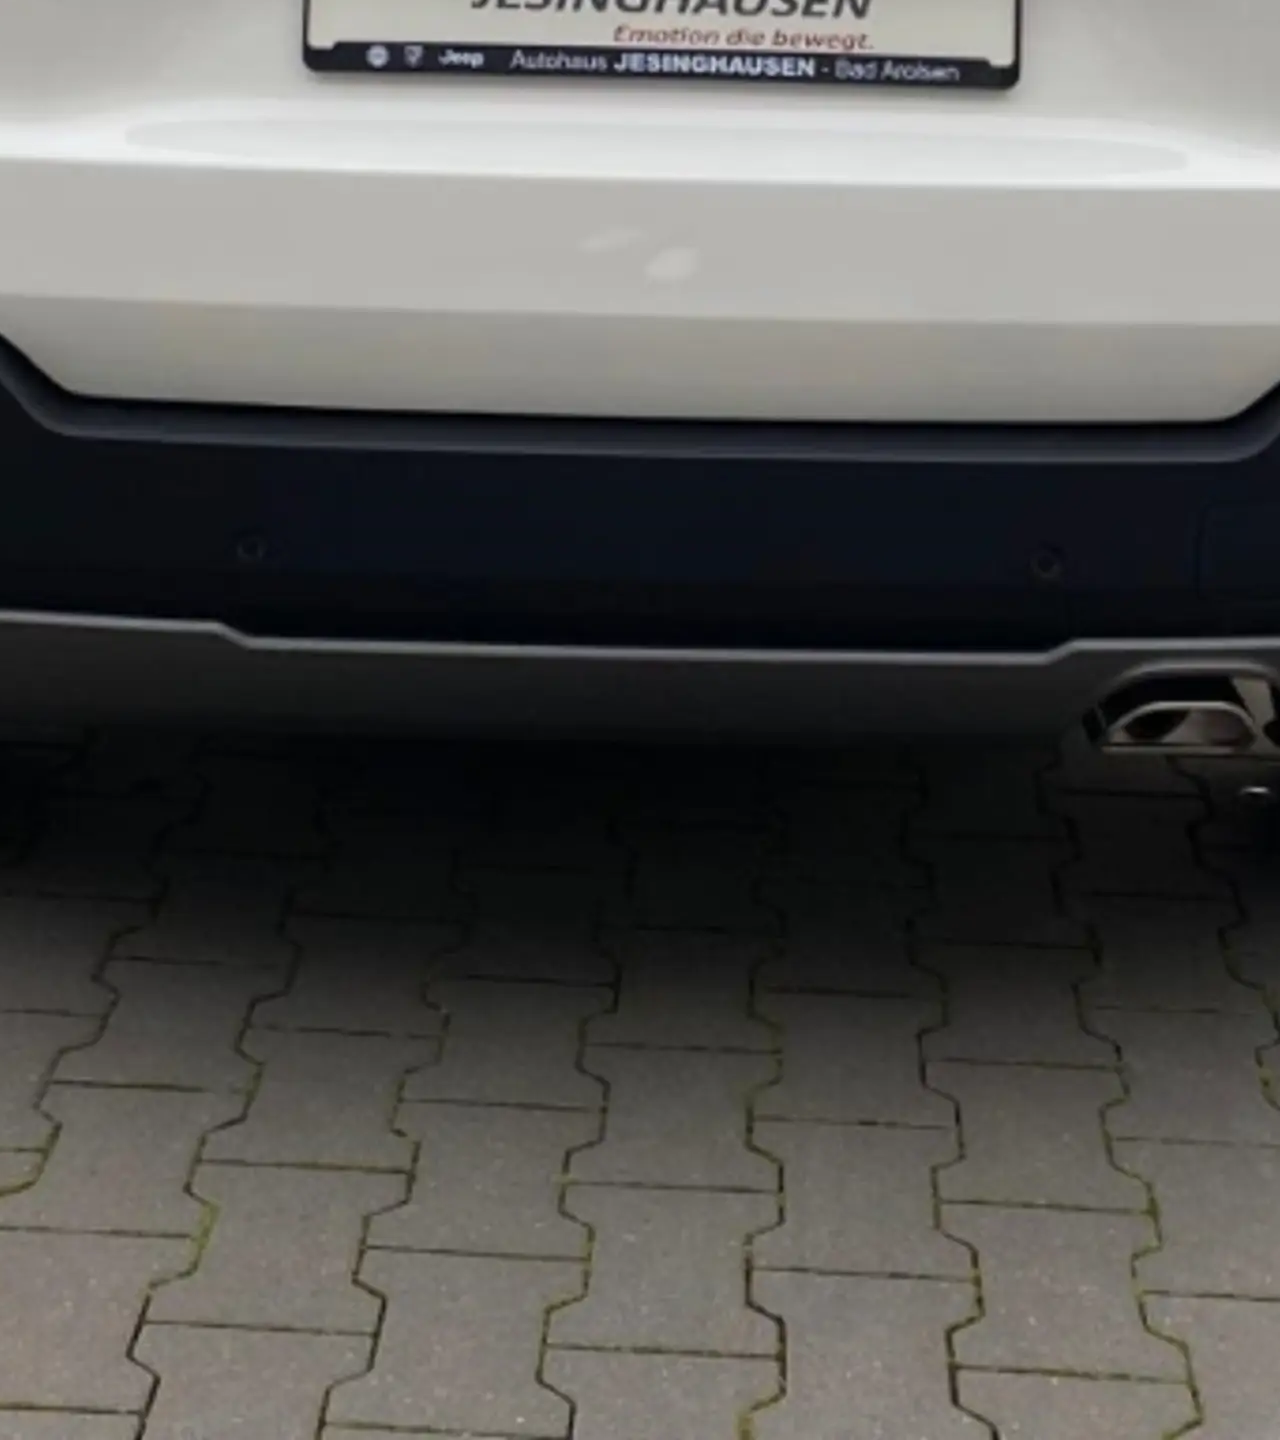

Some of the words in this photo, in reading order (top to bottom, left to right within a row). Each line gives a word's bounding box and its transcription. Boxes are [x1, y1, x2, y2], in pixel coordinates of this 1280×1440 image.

[613, 25, 720, 45] Emotion
[725, 27, 765, 47] die
[771, 29, 874, 51] bewegt.
[509, 48, 608, 72] Autohaus
[614, 51, 815, 78] JESINGHAUSEN
